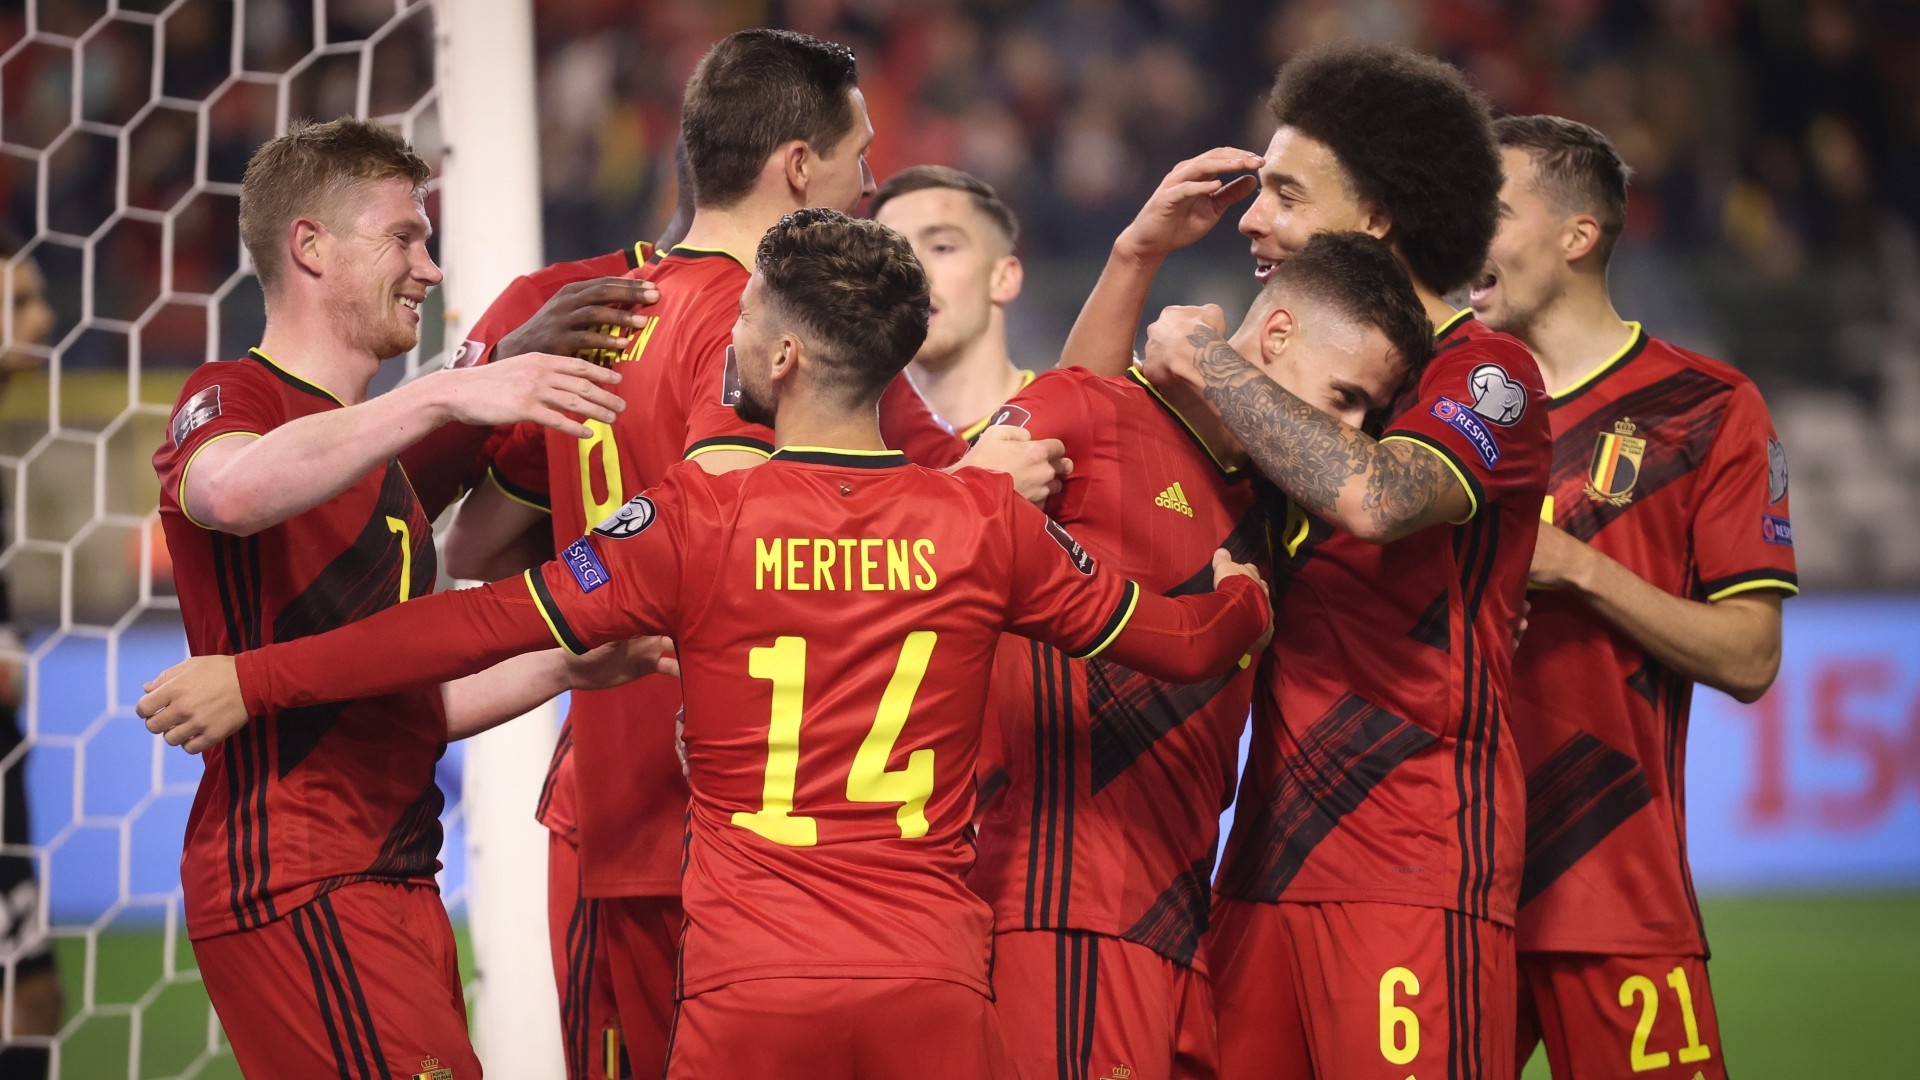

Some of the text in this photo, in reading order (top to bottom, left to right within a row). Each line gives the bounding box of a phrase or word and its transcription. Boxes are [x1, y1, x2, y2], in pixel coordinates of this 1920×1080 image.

[1456, 413, 1498, 463] RESPECT
[1154, 496, 1194, 518] adidas
[386, 515, 411, 604] 7
[567, 540, 603, 588] ESPECT
[755, 537, 938, 592] MERTENS
[730, 630, 938, 847] 14
[1379, 966, 1420, 1065] 6
[1618, 966, 1711, 1073] 21
